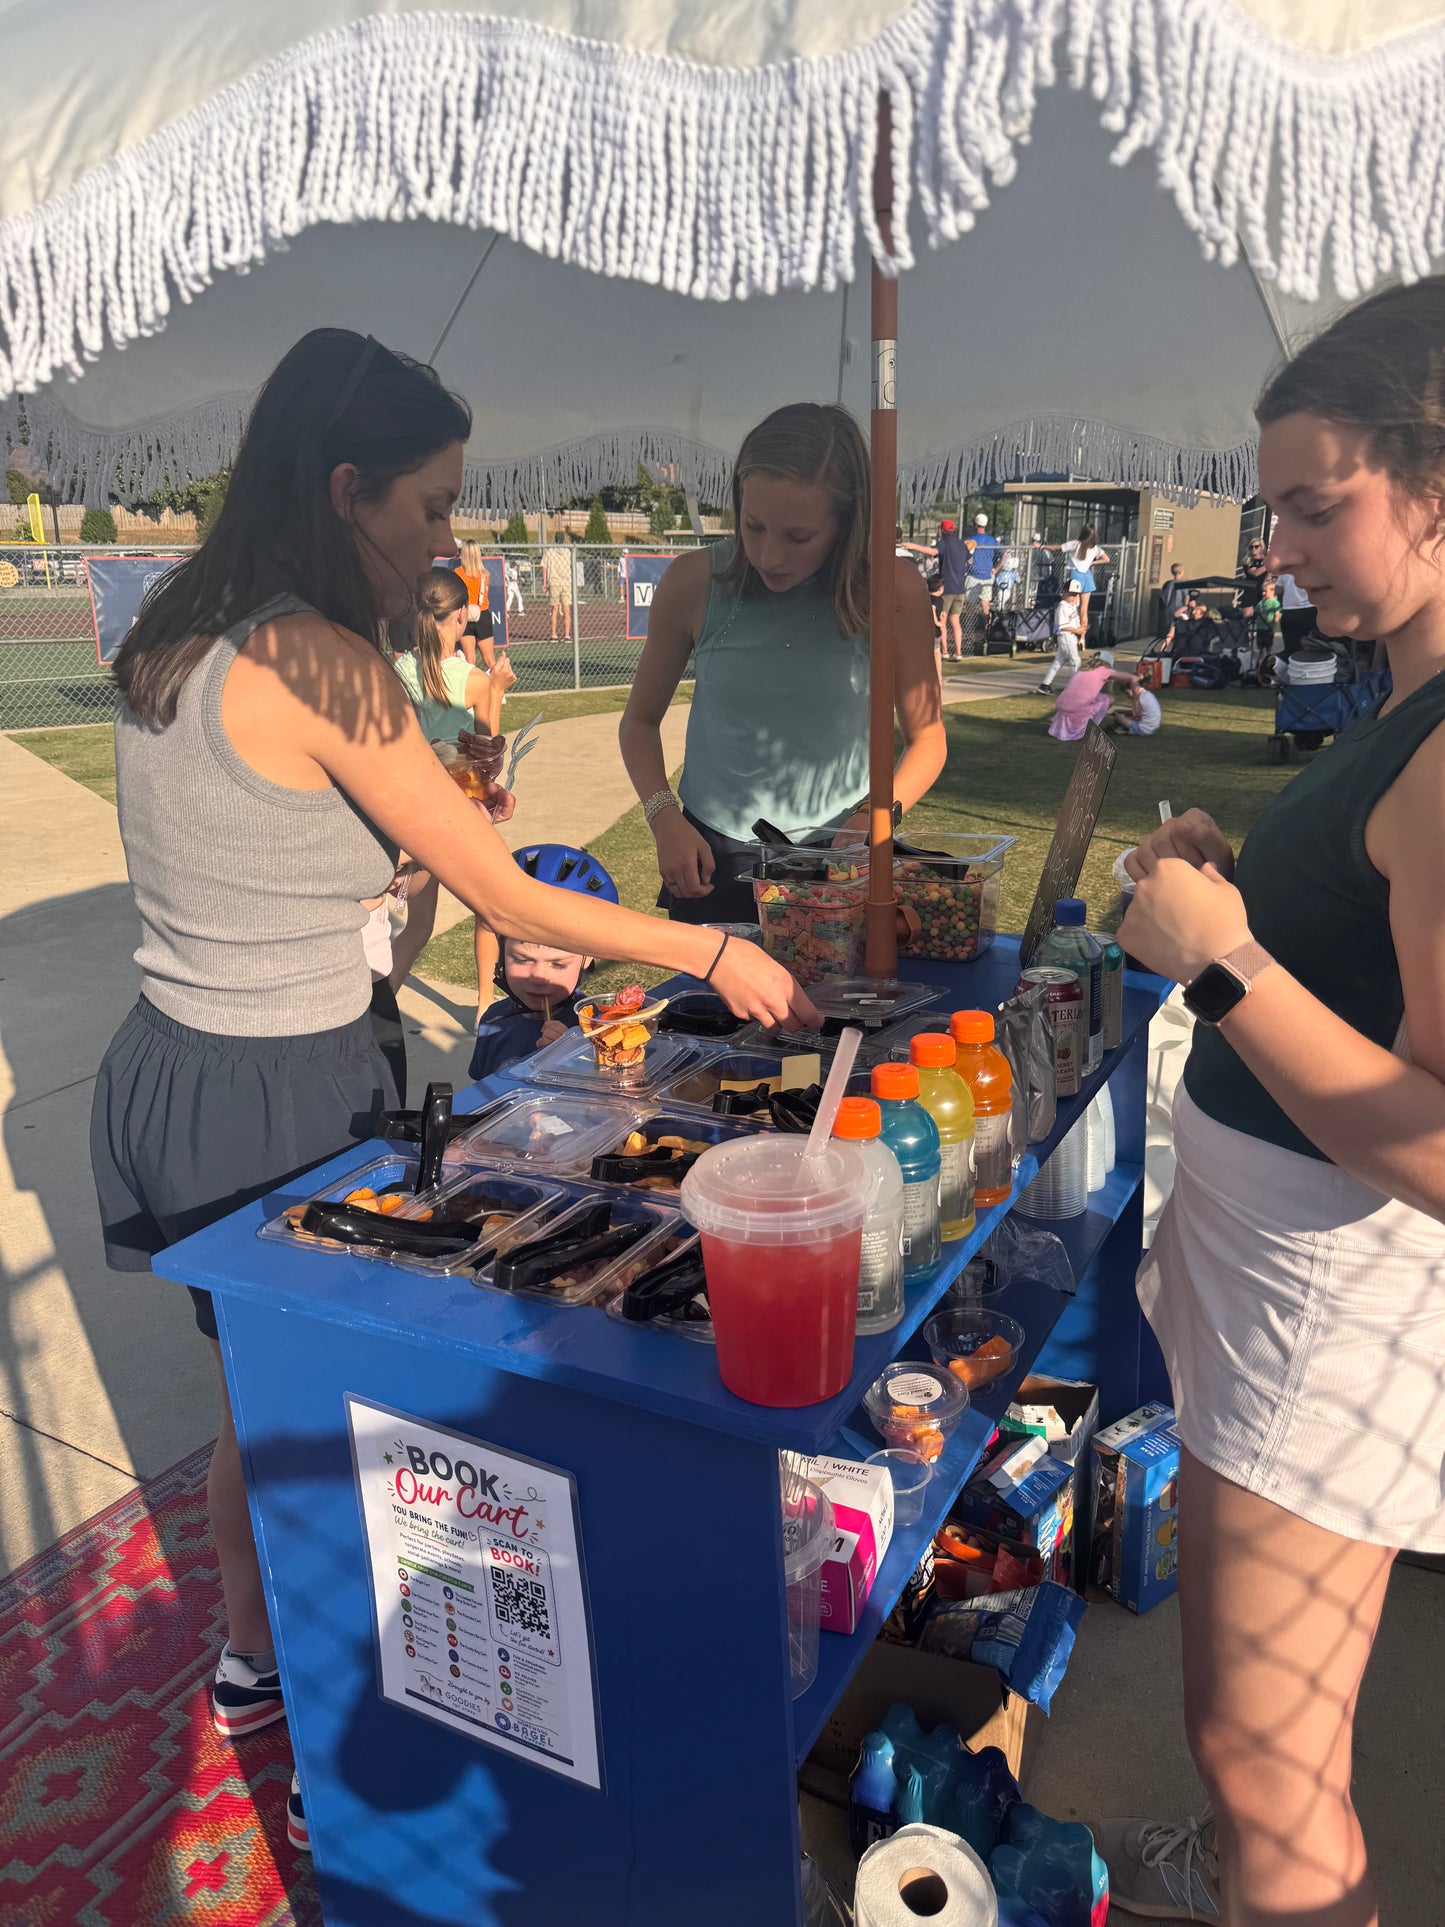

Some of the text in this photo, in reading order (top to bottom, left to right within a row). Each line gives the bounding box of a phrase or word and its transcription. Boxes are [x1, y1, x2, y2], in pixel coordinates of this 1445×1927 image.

[406, 1445, 500, 1502] BOOK
[810, 1467, 868, 1484] Disposable Gloves
[832, 1462, 870, 1476] WHITE
[395, 1468, 530, 1538] Our Cart
[392, 1504, 468, 1541] YOU BRING THE FUN!
[394, 1516, 465, 1549] We bring the cart!
[399, 1531, 416, 1542] Perfect
[492, 1538, 533, 1559] SCAN TO
[420, 1554, 443, 1568] gatherings
[490, 1547, 541, 1577] BOOK!
[509, 1628, 520, 1638] Let's
[447, 1678, 468, 1696] Brought
[444, 1690, 481, 1713] GOODIES
[512, 1721, 554, 1748] BAGEL
